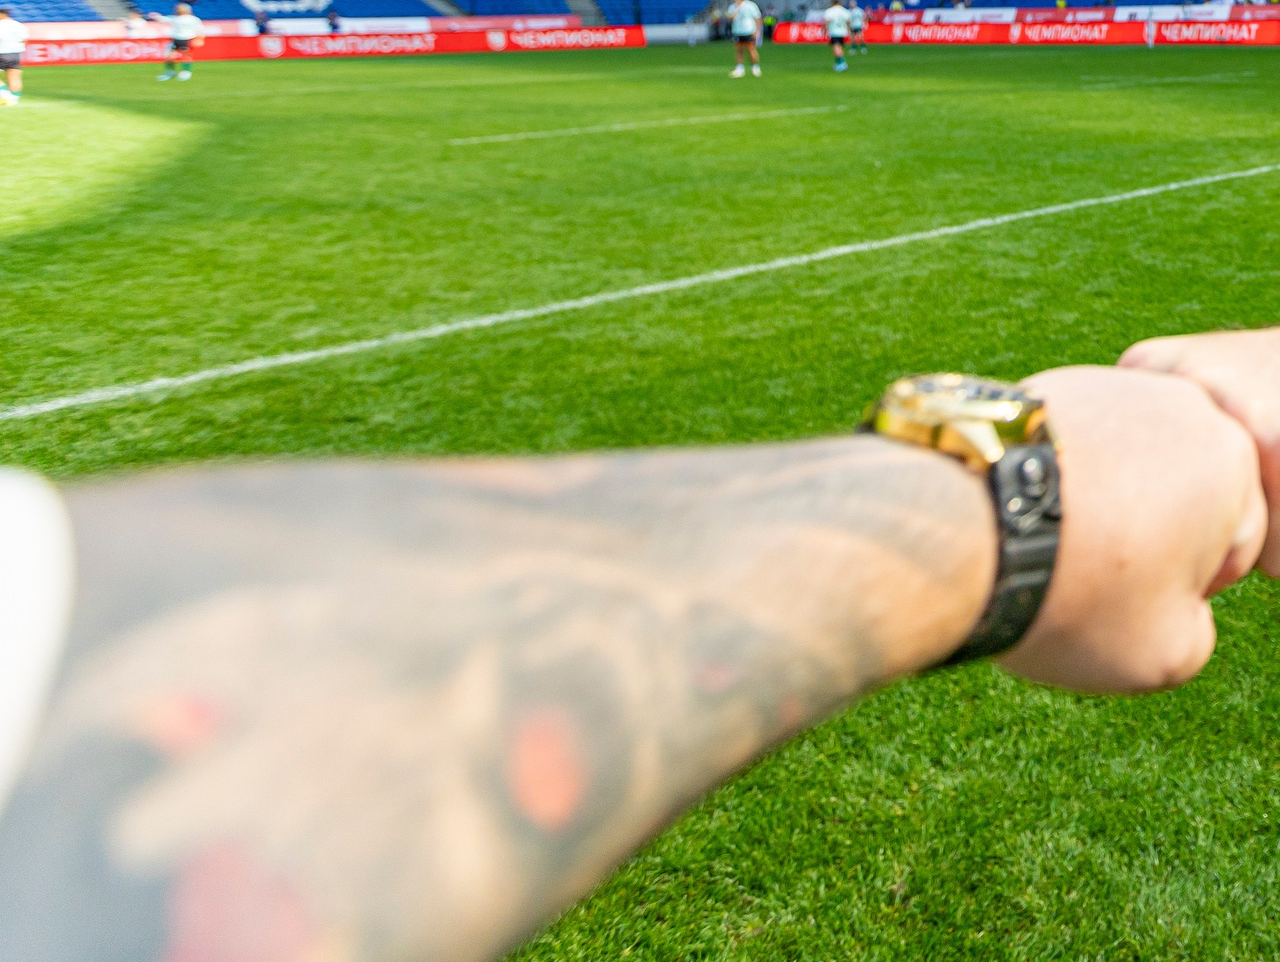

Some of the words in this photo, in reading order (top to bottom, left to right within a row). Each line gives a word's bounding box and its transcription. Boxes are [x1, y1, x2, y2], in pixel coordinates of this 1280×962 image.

[905, 24, 980, 42] ЧЕМПИОНАТ
[1024, 24, 1109, 42] ЧЕМПИОНАТ
[1160, 23, 1260, 41] ЧЕМПИОНАТ
[288, 34, 438, 55] ЧЕМПИОНАТ
